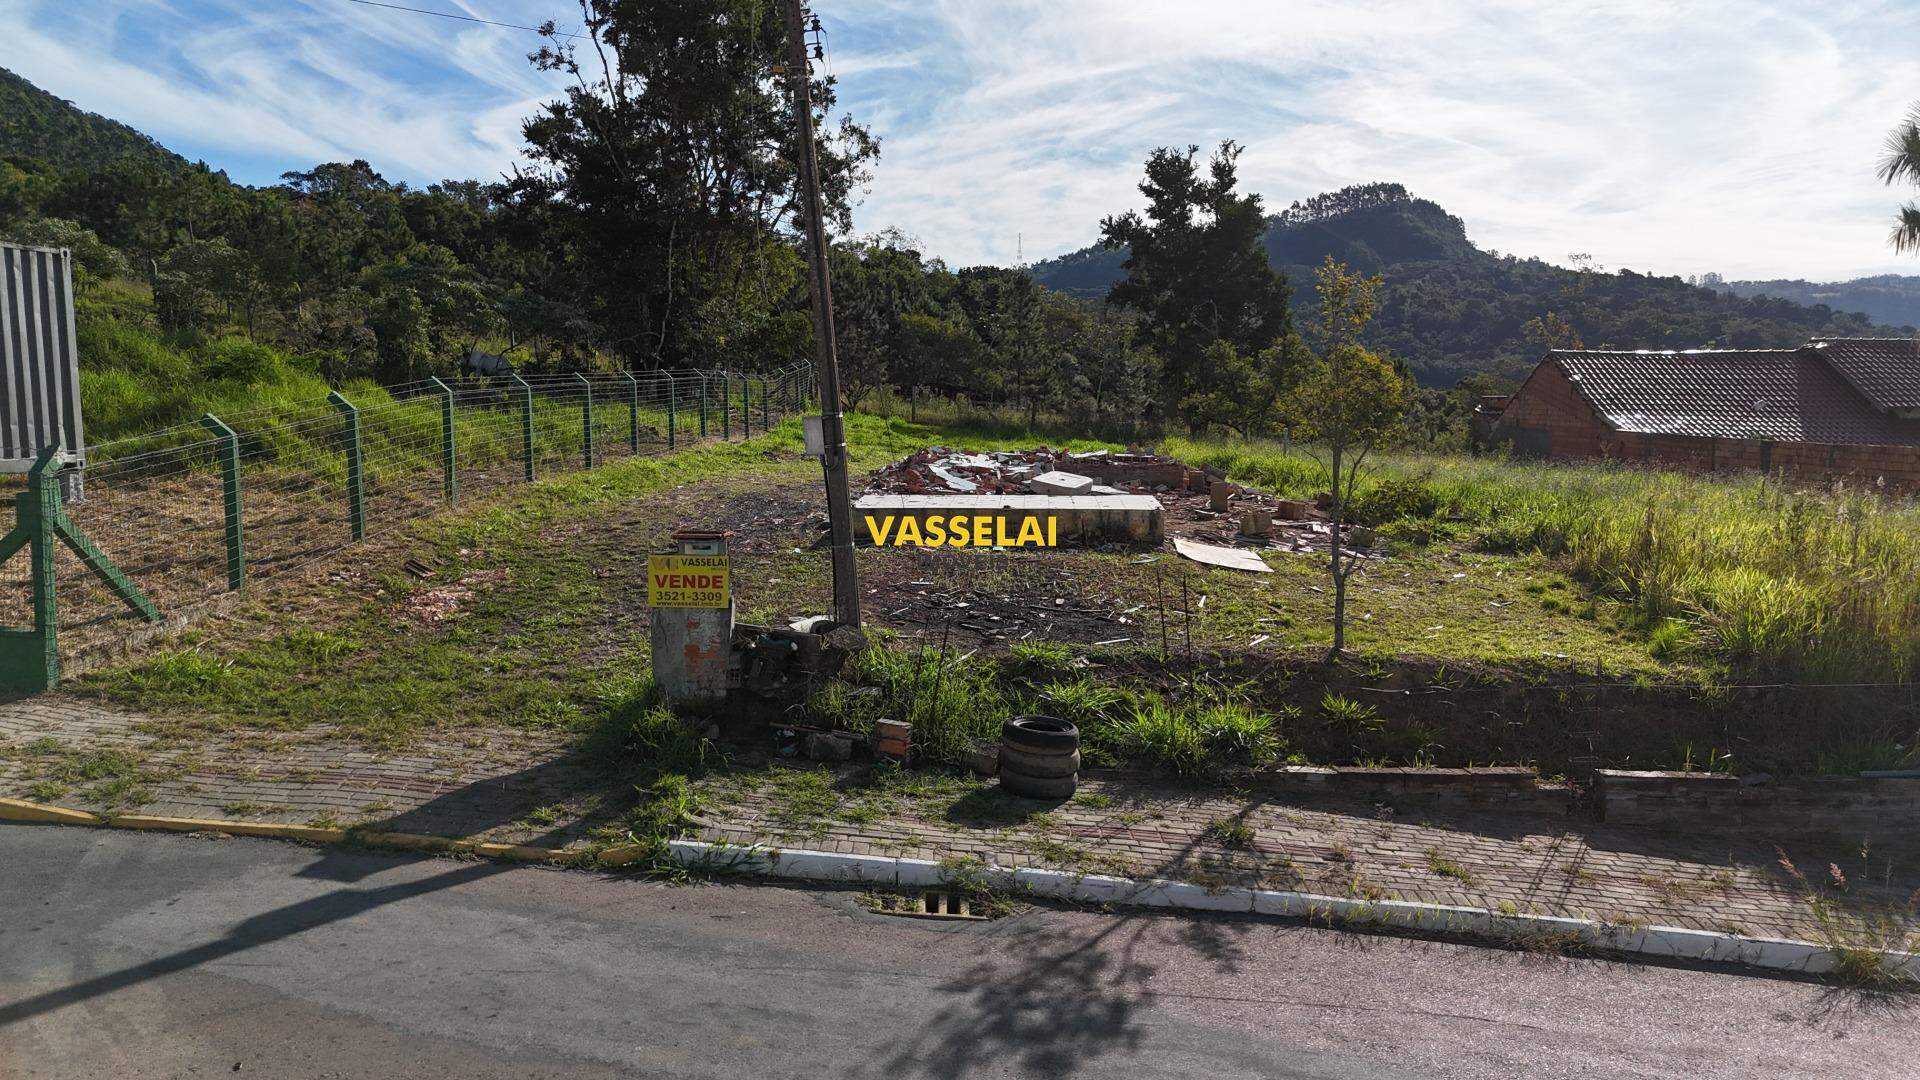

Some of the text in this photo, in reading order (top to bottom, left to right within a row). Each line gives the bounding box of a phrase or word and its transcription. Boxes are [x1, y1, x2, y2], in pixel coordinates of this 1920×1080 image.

[681, 558, 727, 567] VASSELAI
[654, 575, 724, 588] VENDE
[656, 591, 722, 601] 3521-3309
